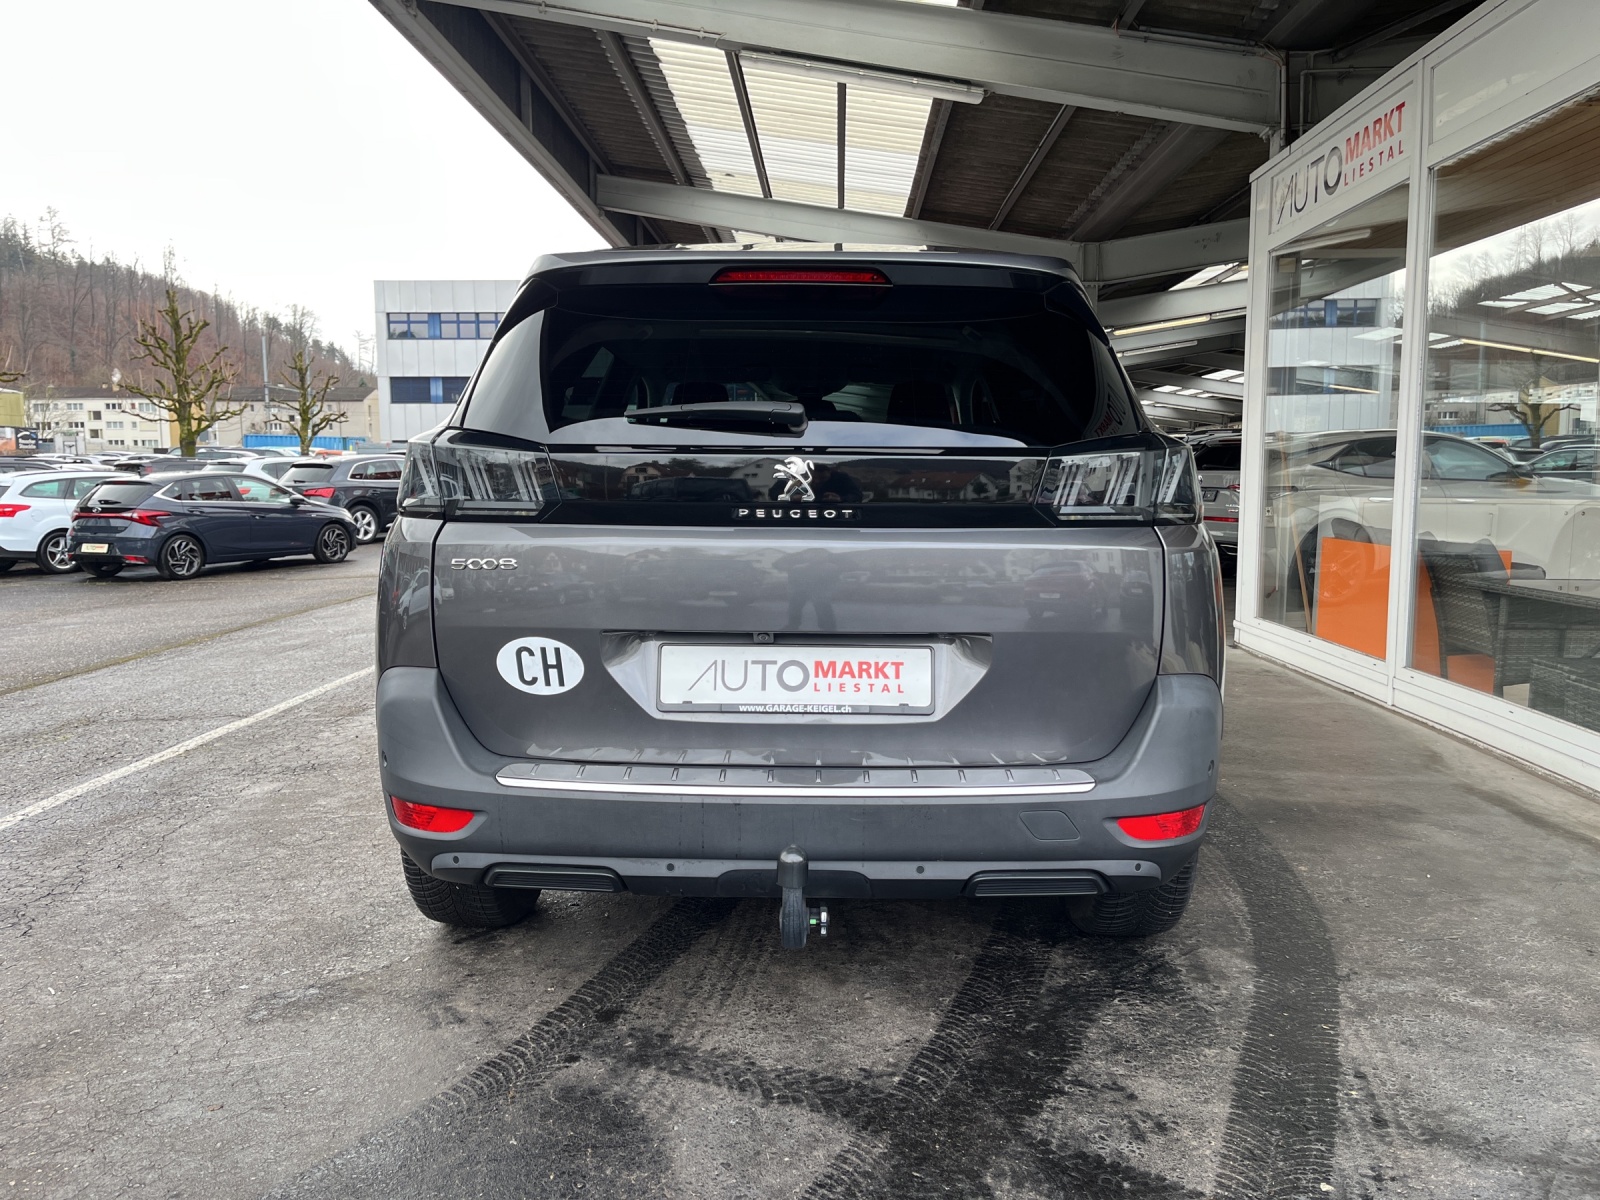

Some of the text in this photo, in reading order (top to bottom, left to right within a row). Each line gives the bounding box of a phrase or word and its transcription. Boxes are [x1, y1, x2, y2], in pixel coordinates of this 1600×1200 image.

[1277, 101, 1406, 225] AUTO MARKT
[1344, 140, 1404, 187] LIESTAL
[738, 508, 853, 519] PEUGEOT
[451, 558, 518, 570] 5008
[515, 646, 565, 687] CH
[687, 659, 904, 692] AUTO MARKT
[813, 682, 905, 693] LIESTAL
[738, 704, 852, 714] www.GARAGE-KEIGEL.ch
